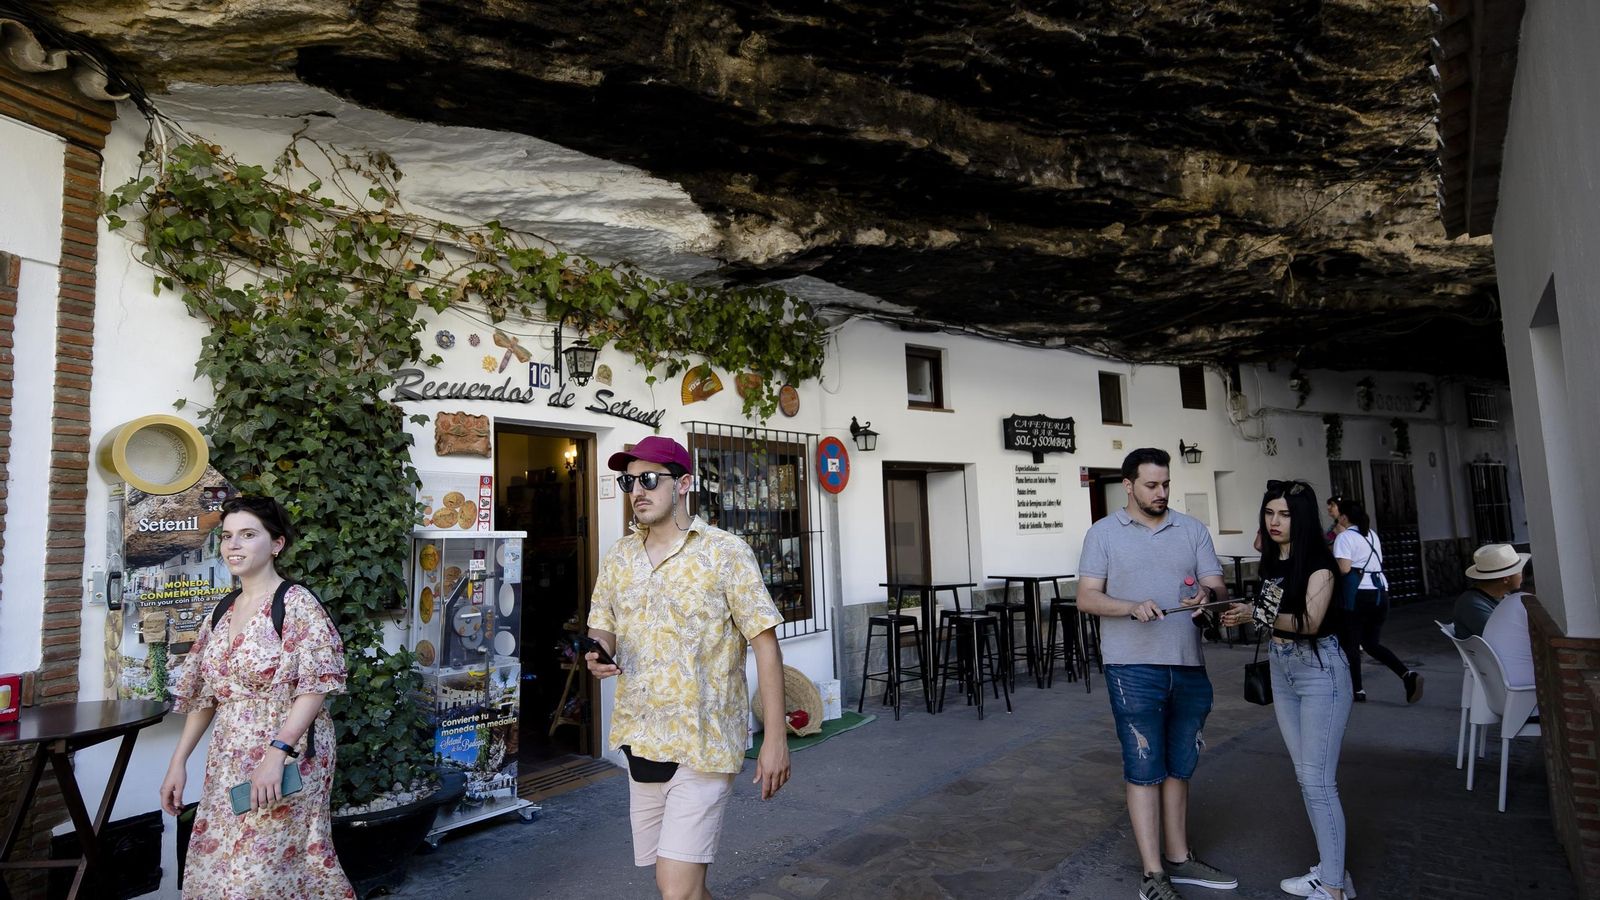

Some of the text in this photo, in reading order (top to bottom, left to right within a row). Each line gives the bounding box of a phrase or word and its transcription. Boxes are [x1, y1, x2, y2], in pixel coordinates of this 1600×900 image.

[530, 364, 550, 387] 16
[391, 368, 666, 429] Recuerdos de Setenil
[1014, 420, 1070, 430] CAFETERIA
[1032, 428, 1054, 436] BAR
[1014, 435, 1072, 449] SOL y SOMBRA
[139, 516, 199, 532] Setenil
[164, 580, 210, 589] MONEDA
[140, 587, 232, 600] CONMEMORATIVA
[481, 712, 489, 720] tu
[441, 716, 517, 737] moneda en medalla
